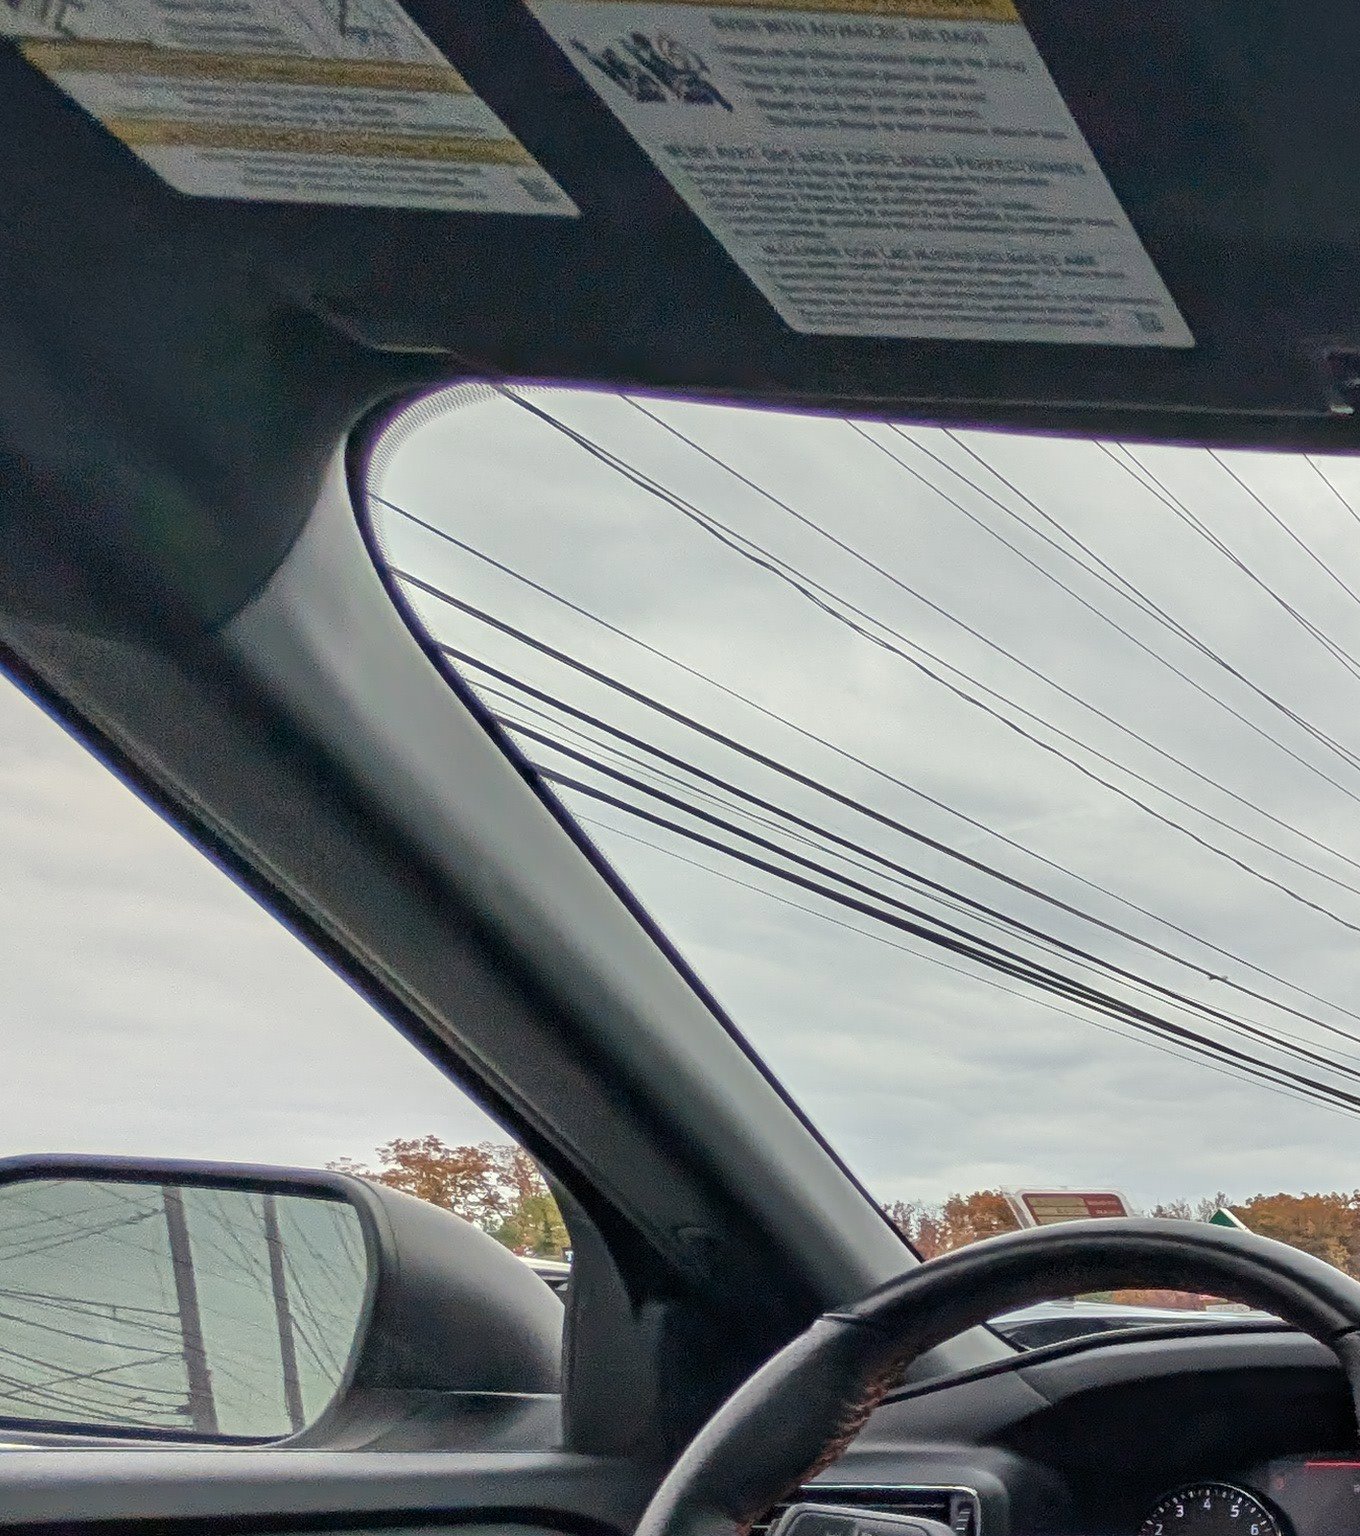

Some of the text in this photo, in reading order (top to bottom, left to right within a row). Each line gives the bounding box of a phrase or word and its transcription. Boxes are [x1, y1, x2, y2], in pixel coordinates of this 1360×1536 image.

[1202, 1499, 1212, 1511] 4
[1175, 1505, 1185, 1518] 3
[1230, 1505, 1240, 1518] 5
[1155, 1524, 1163, 1536] 2
[1250, 1524, 1260, 1536] 6
